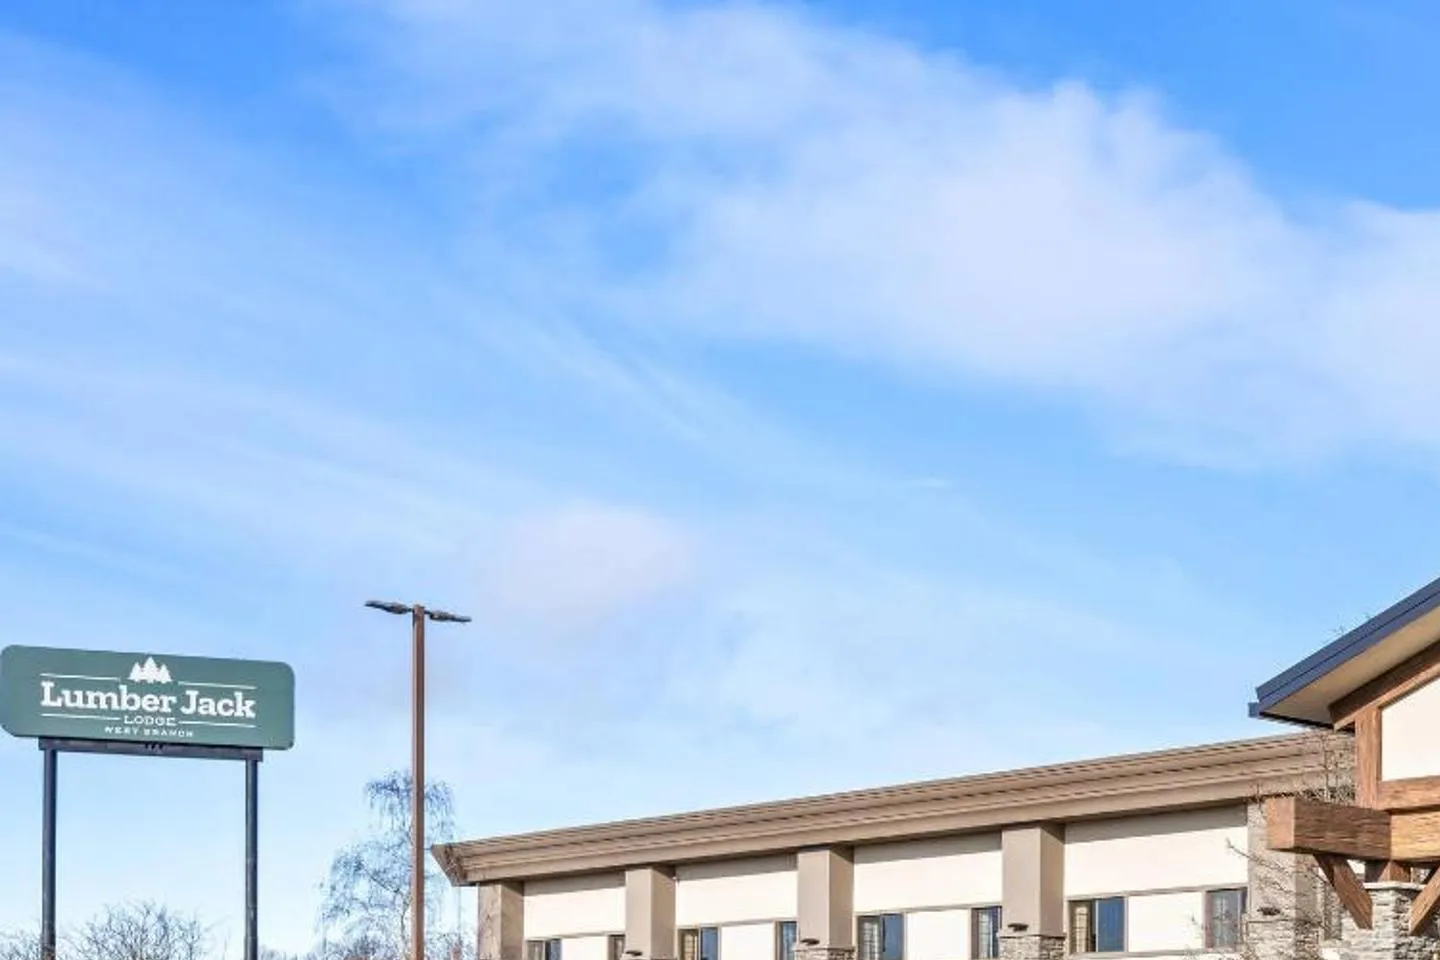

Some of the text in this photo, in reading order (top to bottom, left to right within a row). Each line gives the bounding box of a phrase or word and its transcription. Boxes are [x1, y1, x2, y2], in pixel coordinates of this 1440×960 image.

[40, 680, 256, 718] Lumber Jack
[123, 715, 177, 726] LODGE
